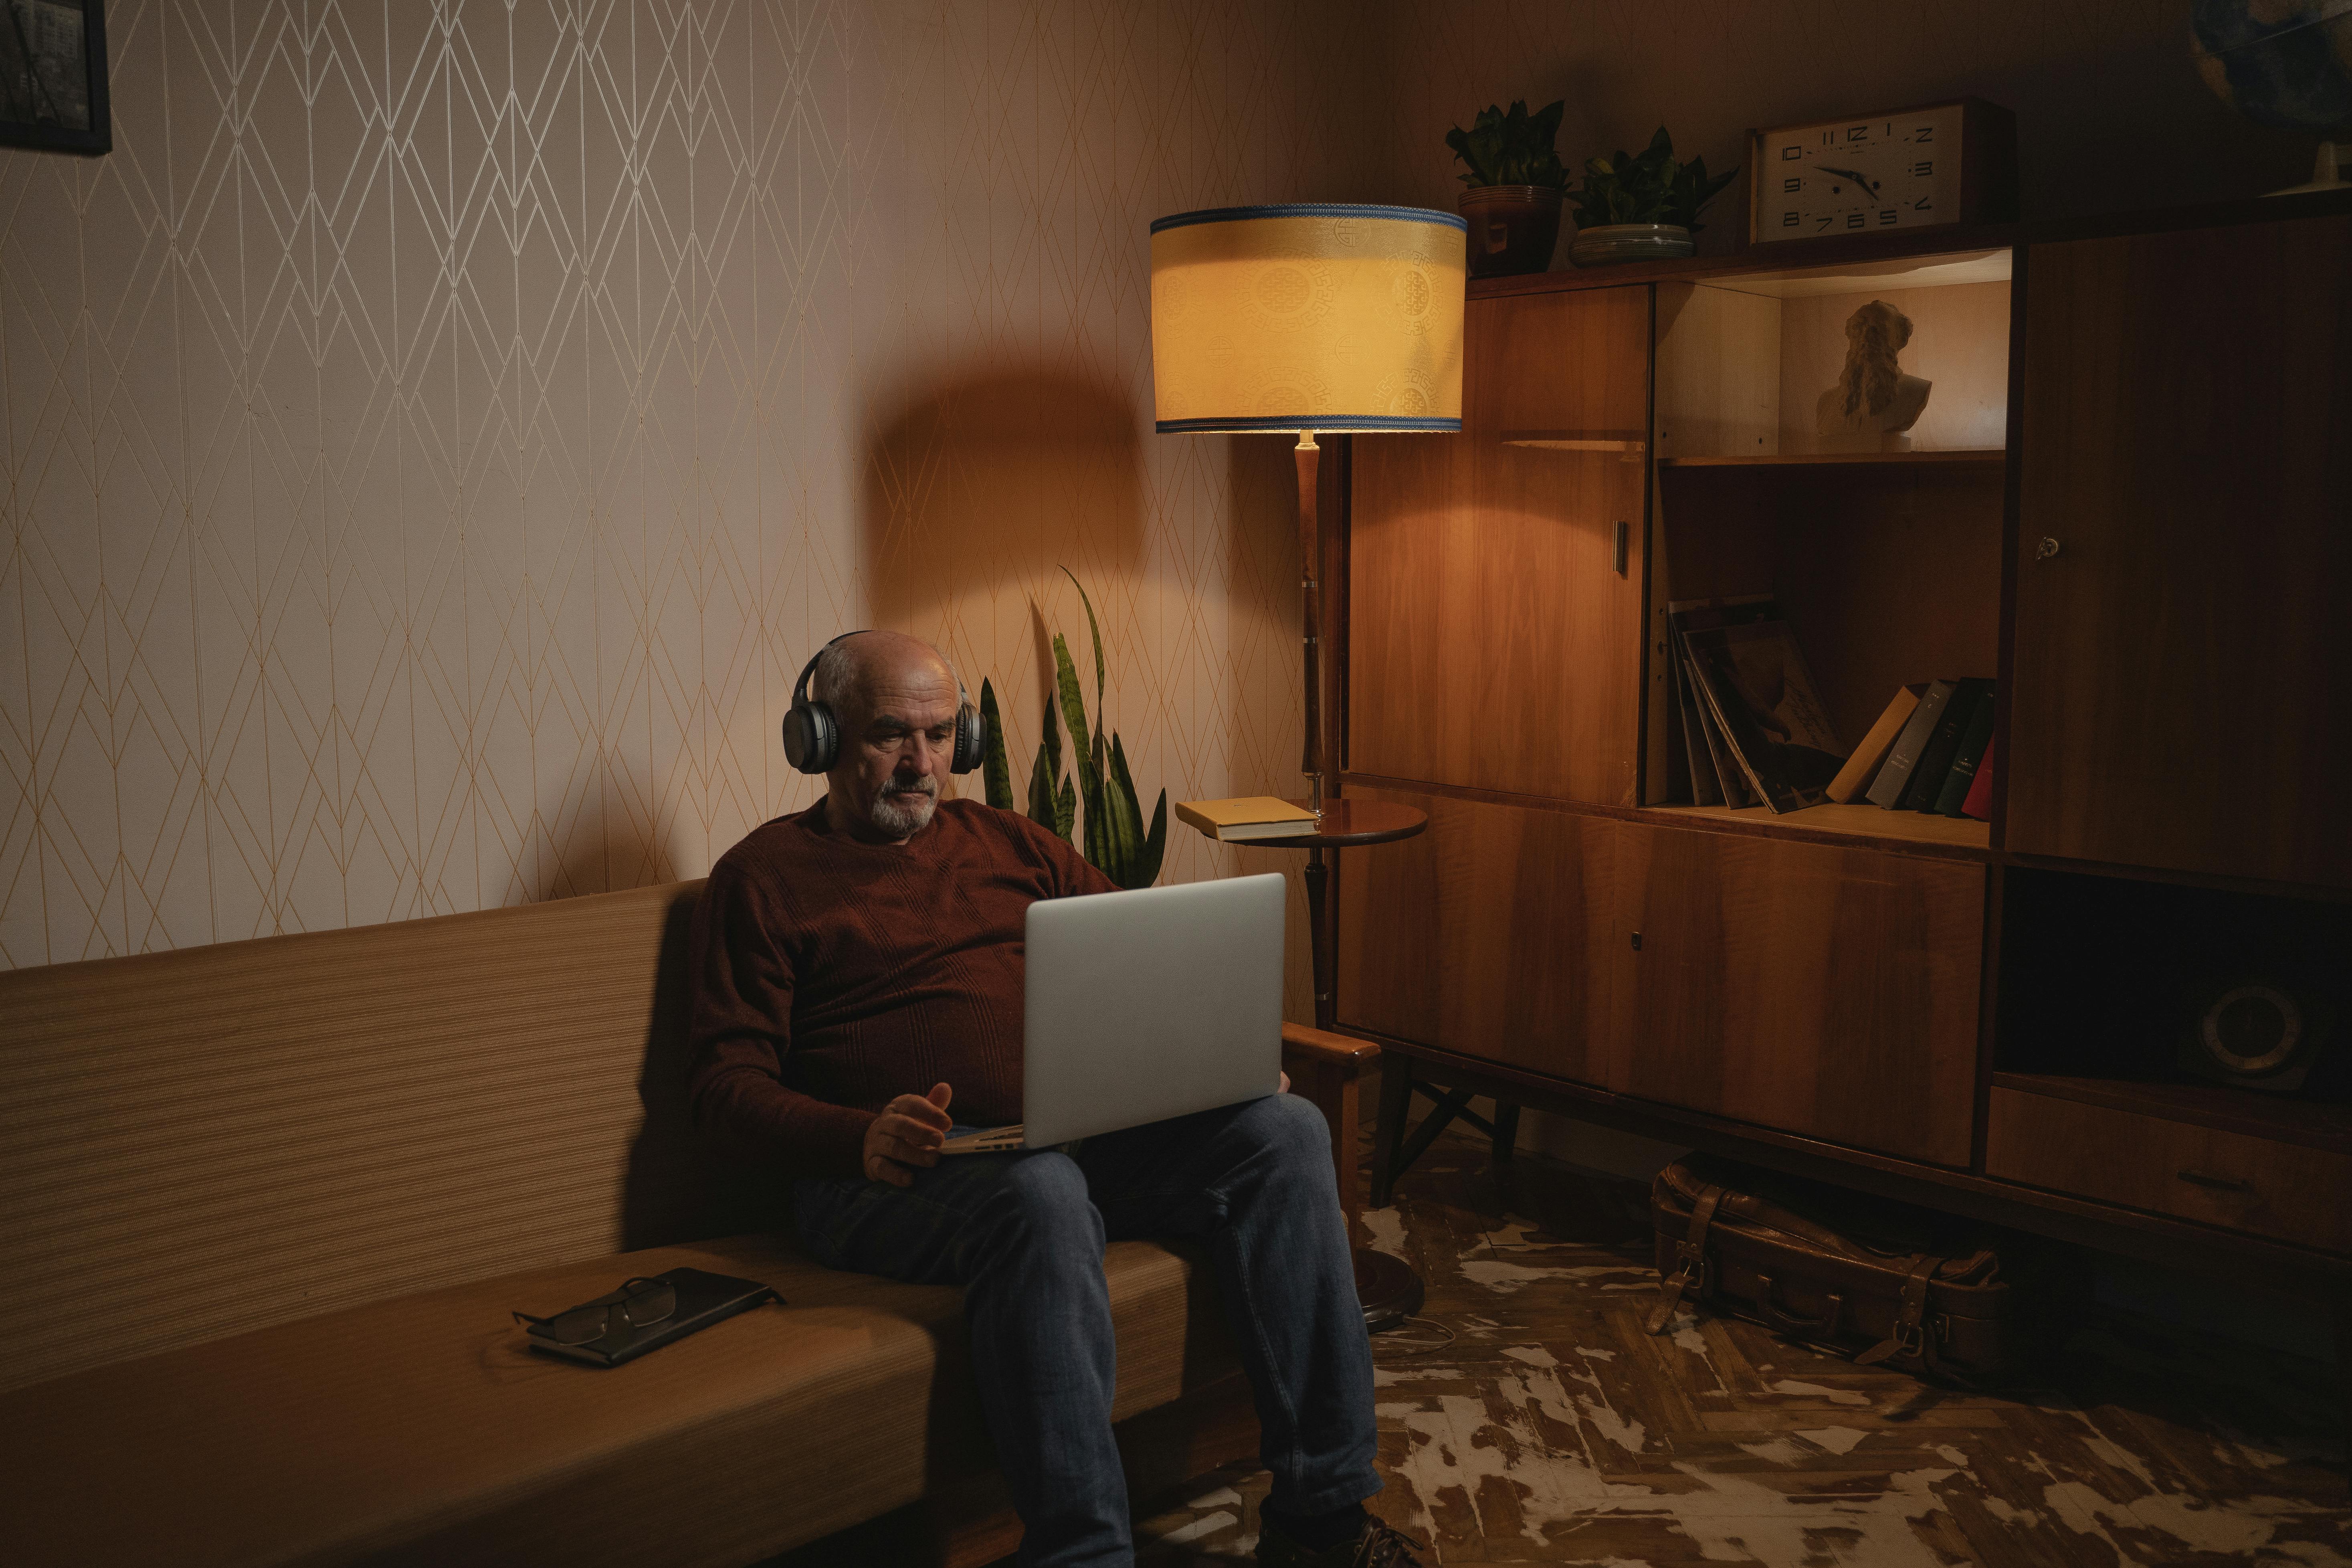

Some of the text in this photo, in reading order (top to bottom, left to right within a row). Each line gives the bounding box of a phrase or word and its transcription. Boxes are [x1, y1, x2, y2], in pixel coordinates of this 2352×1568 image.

[1847, 126, 1868, 142] 12
[1887, 123, 1891, 136] 1
[1916, 127, 1933, 143] 2
[1823, 131, 1834, 145] 11
[1782, 146, 1801, 161] 10
[1915, 162, 1933, 177] 3
[1784, 178, 1800, 193] 9
[1915, 196, 1932, 210] 4
[1783, 212, 1799, 227] 8
[1816, 217, 1833, 232] 7
[1847, 214, 1865, 229] 6
[1880, 210, 1897, 225] 5
